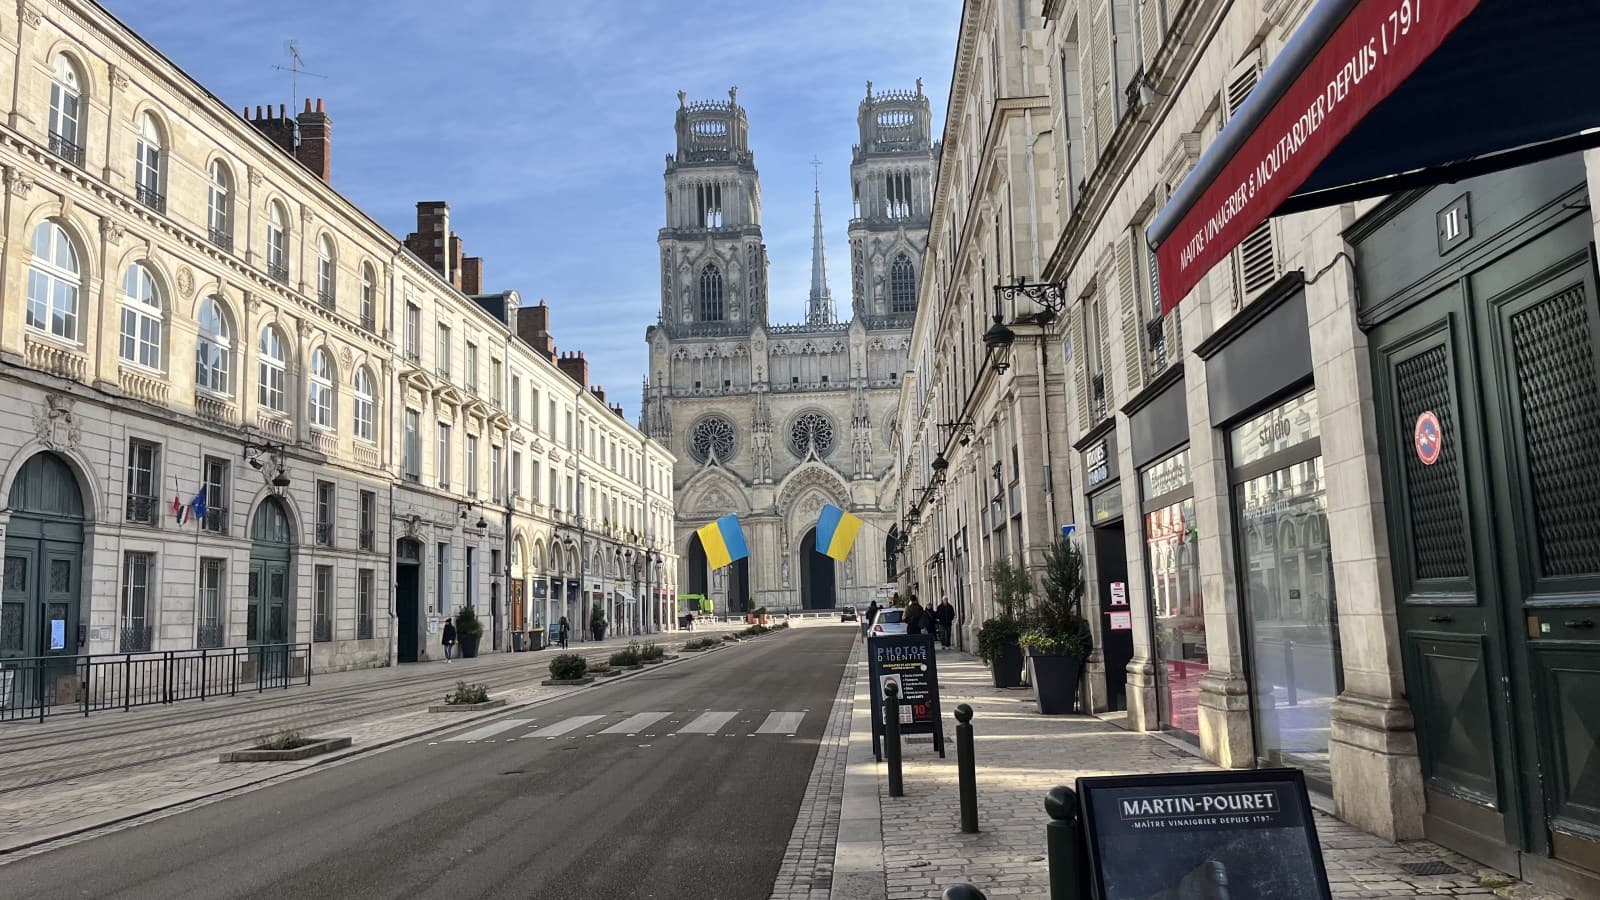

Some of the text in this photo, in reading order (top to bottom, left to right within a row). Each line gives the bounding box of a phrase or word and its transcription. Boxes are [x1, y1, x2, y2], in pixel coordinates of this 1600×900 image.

[1205, 181, 1248, 243] VINAIGRIER
[1249, 173, 1255, 198] &
[1256, 94, 1325, 191] MOUTARDIER
[1327, 37, 1376, 113] DEPUIS
[1259, 416, 1291, 447] studio
[877, 646, 926, 655] PHOTOS
[1123, 793, 1273, 816] MARTIN-POURET
[1168, 818, 1217, 827] VINAIGRIER
